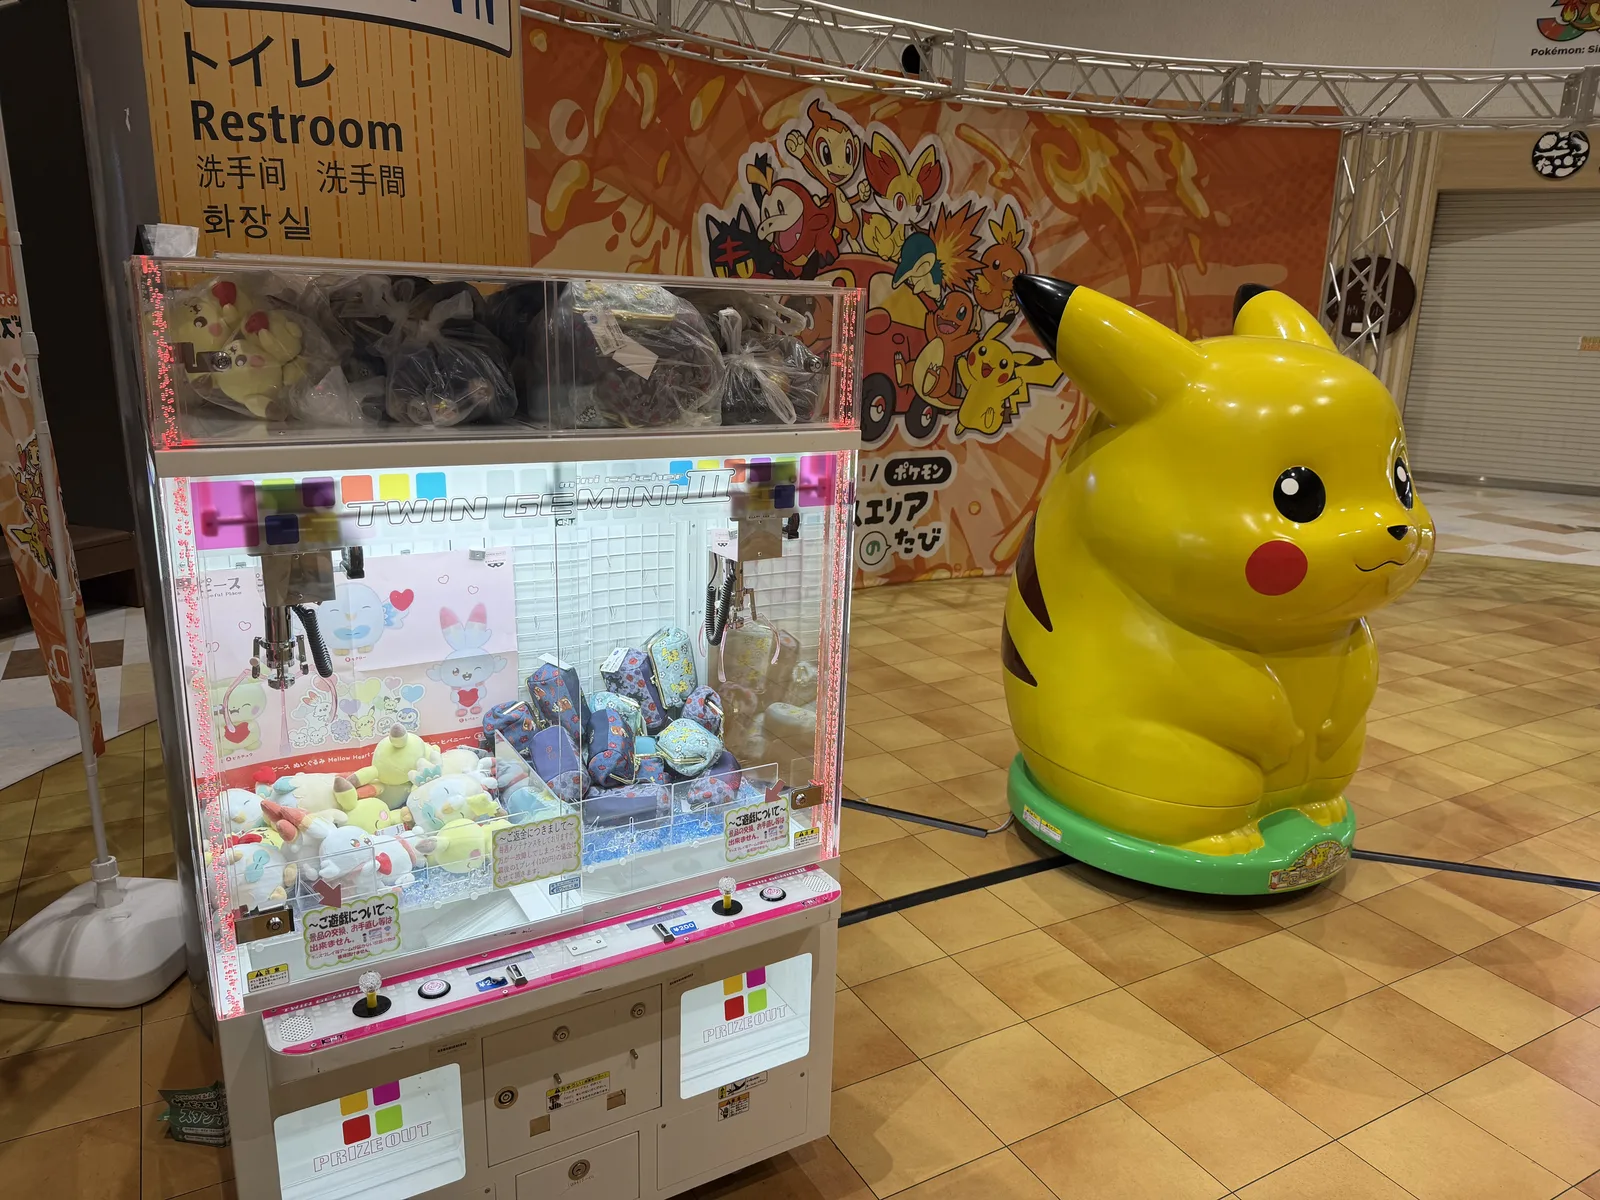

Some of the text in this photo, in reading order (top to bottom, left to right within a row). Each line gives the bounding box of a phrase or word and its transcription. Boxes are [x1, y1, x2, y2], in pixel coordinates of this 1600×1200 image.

[184, 31, 335, 88] トイレ
[1531, 47, 1585, 56] Pokémon:
[191, 100, 403, 152] Restroom
[196, 154, 405, 198] 洗手间 洗手間
[203, 203, 311, 240] 화장실
[893, 461, 944, 480] ポケモン
[347, 497, 488, 527] TWIN
[502, 484, 680, 519] GEMINI
[327, 754, 350, 763] Mellow
[309, 903, 394, 929] ～ご遊戯について～
[673, 922, 695, 932] ¥200
[309, 937, 355, 953] 出来ません。
[703, 1003, 787, 1043] PRIZE OUT
[313, 1121, 432, 1173] PRIZE OUT
